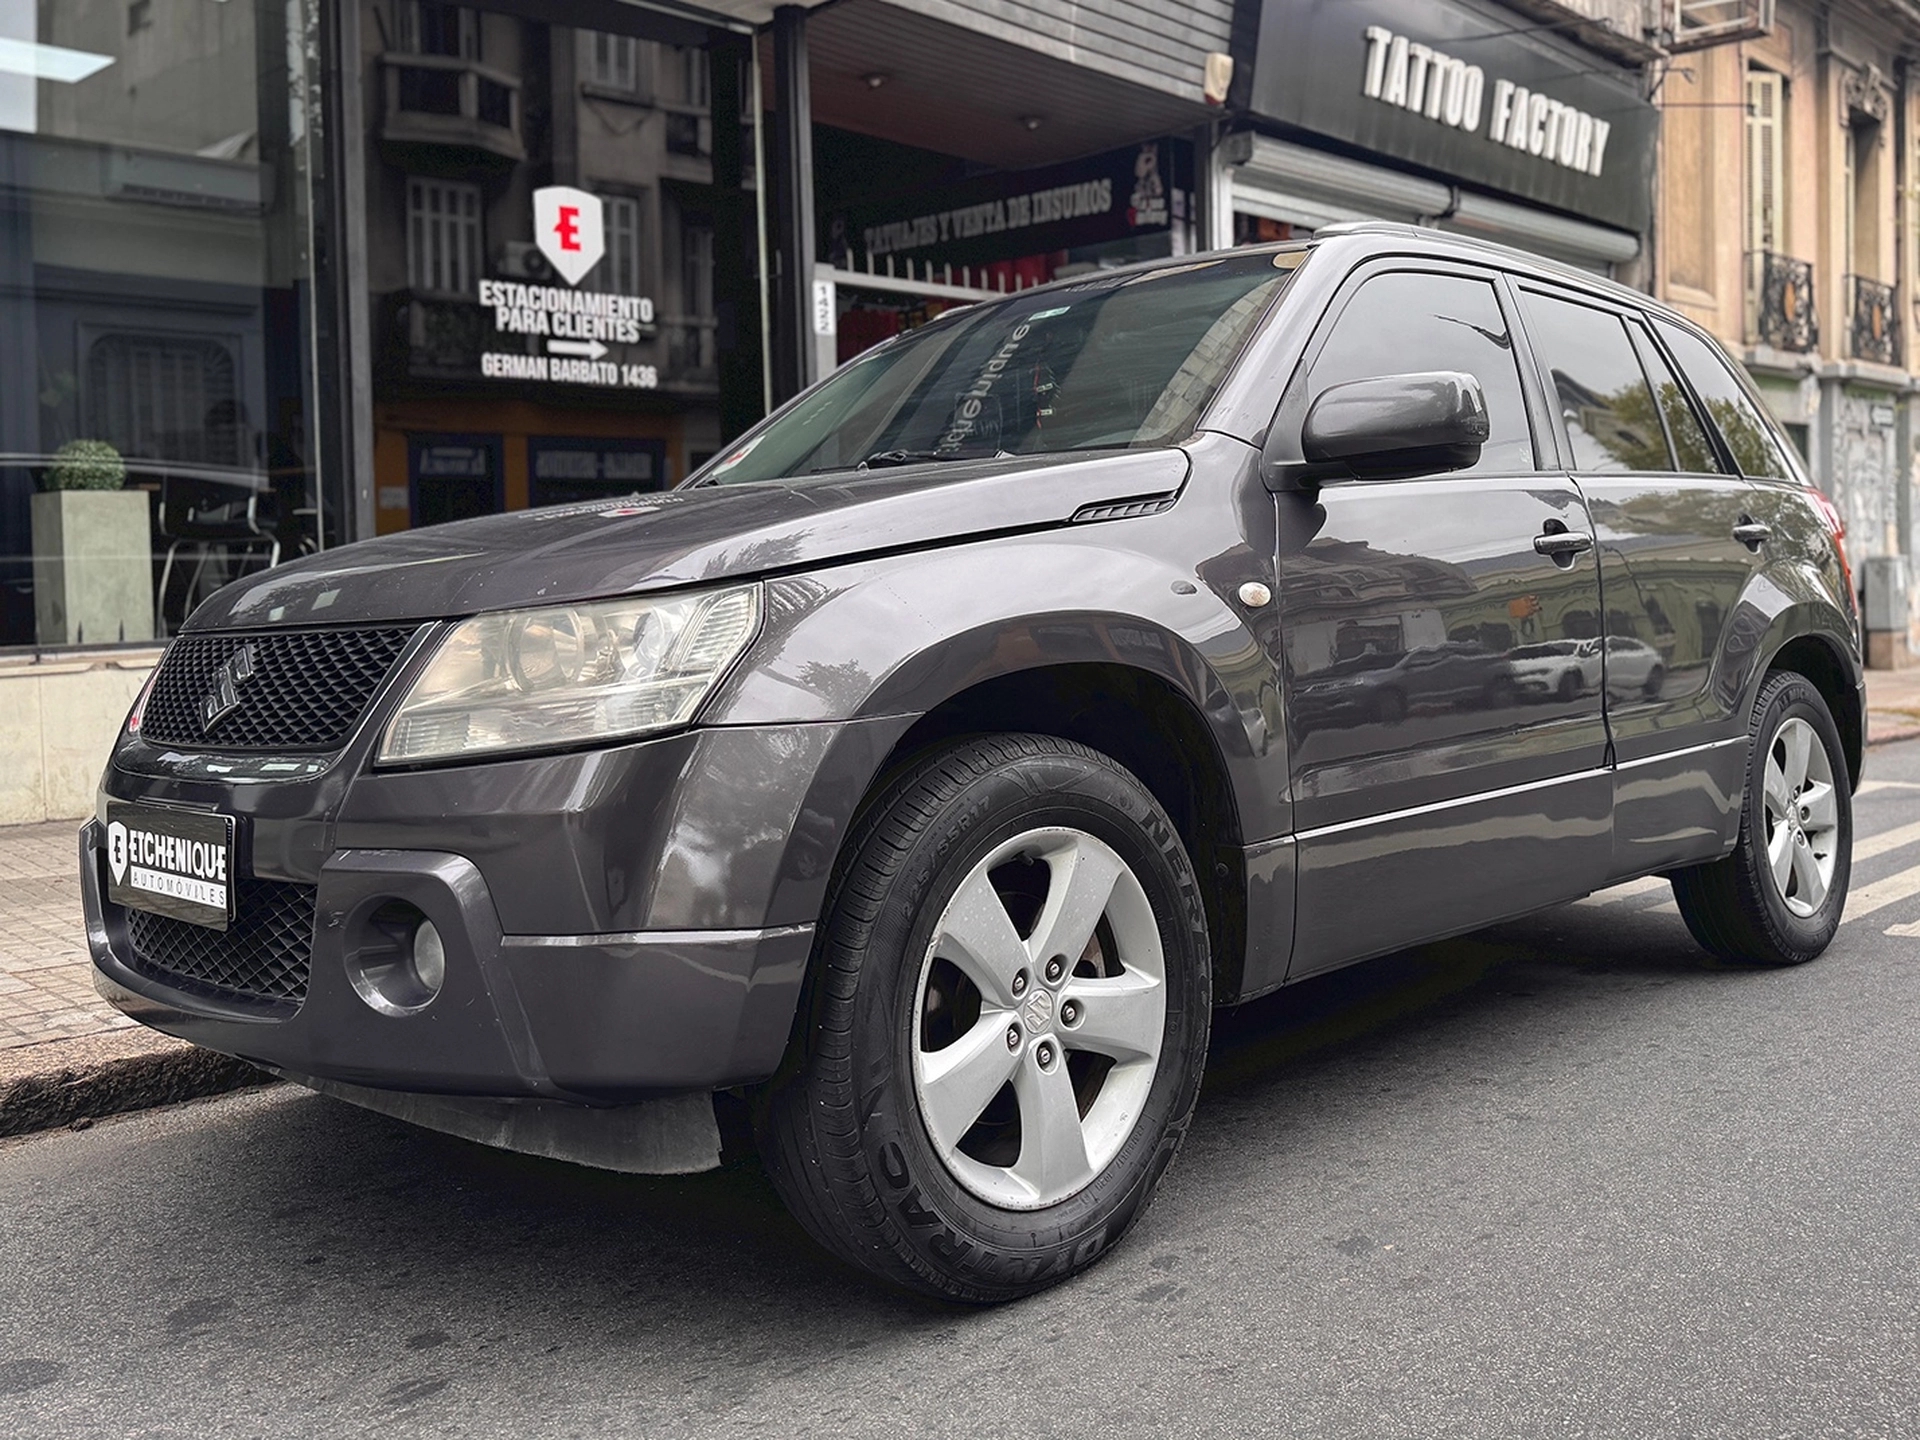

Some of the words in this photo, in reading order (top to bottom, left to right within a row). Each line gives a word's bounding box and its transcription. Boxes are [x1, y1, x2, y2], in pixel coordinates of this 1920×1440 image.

[1364, 25, 1485, 132] TATTOO
[1489, 79, 1611, 177] FACTORY
[938, 210, 951, 242] Y
[952, 199, 1006, 239] VENTA
[1006, 194, 1031, 230] DE
[1032, 178, 1112, 224] INSUMOS
[478, 279, 654, 321] ESTACIONAMIENTO
[496, 306, 550, 336] PARA
[552, 311, 641, 343] CLIENTES
[481, 352, 548, 380] GERMAN
[551, 358, 619, 386] BARBATO
[620, 364, 658, 389] 1436
[128, 829, 227, 882] ETCHENIQUE
[133, 870, 226, 906] AUTOMÓVILES
